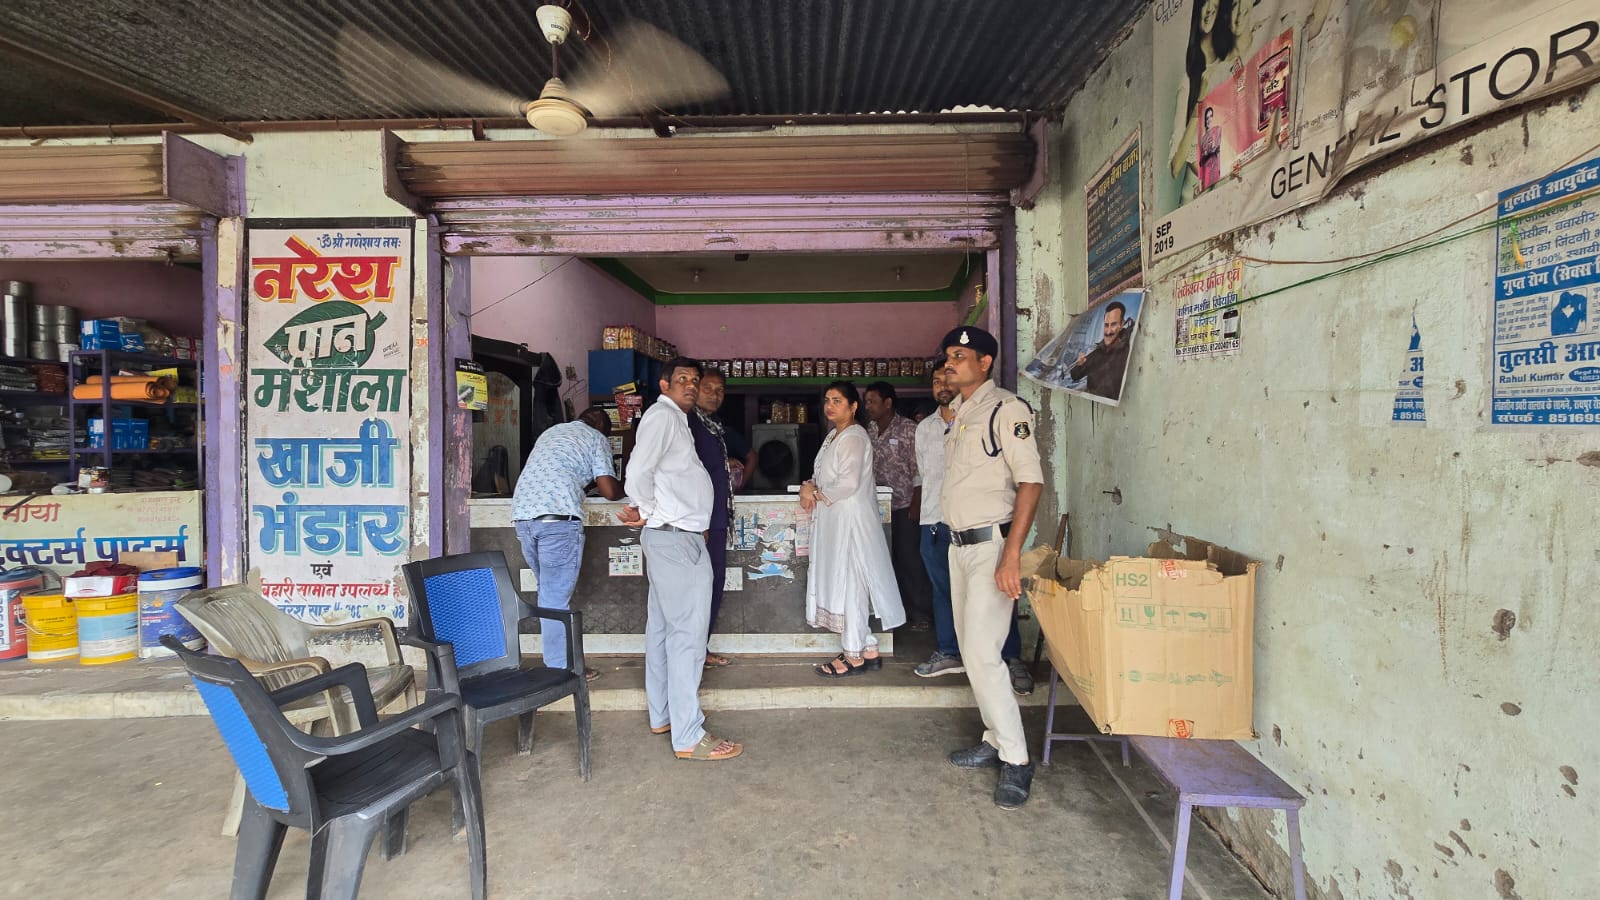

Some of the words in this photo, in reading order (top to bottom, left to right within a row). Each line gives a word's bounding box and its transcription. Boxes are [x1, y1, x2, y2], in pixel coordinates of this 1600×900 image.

[1419, 20, 1600, 130] STOR
[1503, 184, 1542, 212] तुलसी
[1545, 166, 1599, 195] आयुर्वेद
[1156, 221, 1172, 239] SEP
[1556, 227, 1590, 248] जिंदगी
[332, 232, 344, 249] श्री
[345, 233, 381, 250] गणेशाय
[383, 236, 401, 249] नमः
[1154, 235, 1174, 255] 2019
[252, 234, 402, 304] नरेश
[1537, 253, 1562, 265] 100%
[1503, 276, 1526, 296] गुप्त
[1528, 271, 1549, 287] रोग
[1553, 262, 1593, 286] (सेक्स
[285, 313, 368, 360] पान
[1498, 341, 1559, 373] तुलसी
[1499, 373, 1527, 384] Rahul
[1529, 373, 1565, 383] Kumar
[251, 368, 407, 413] मशाला
[1496, 412, 1534, 423] संपर्क
[254, 417, 401, 488] खाजी
[252, 491, 408, 556] भंडार
[310, 561, 334, 580] एवं
[1115, 573, 1148, 587] HS2
[296, 583, 339, 601] सामान
